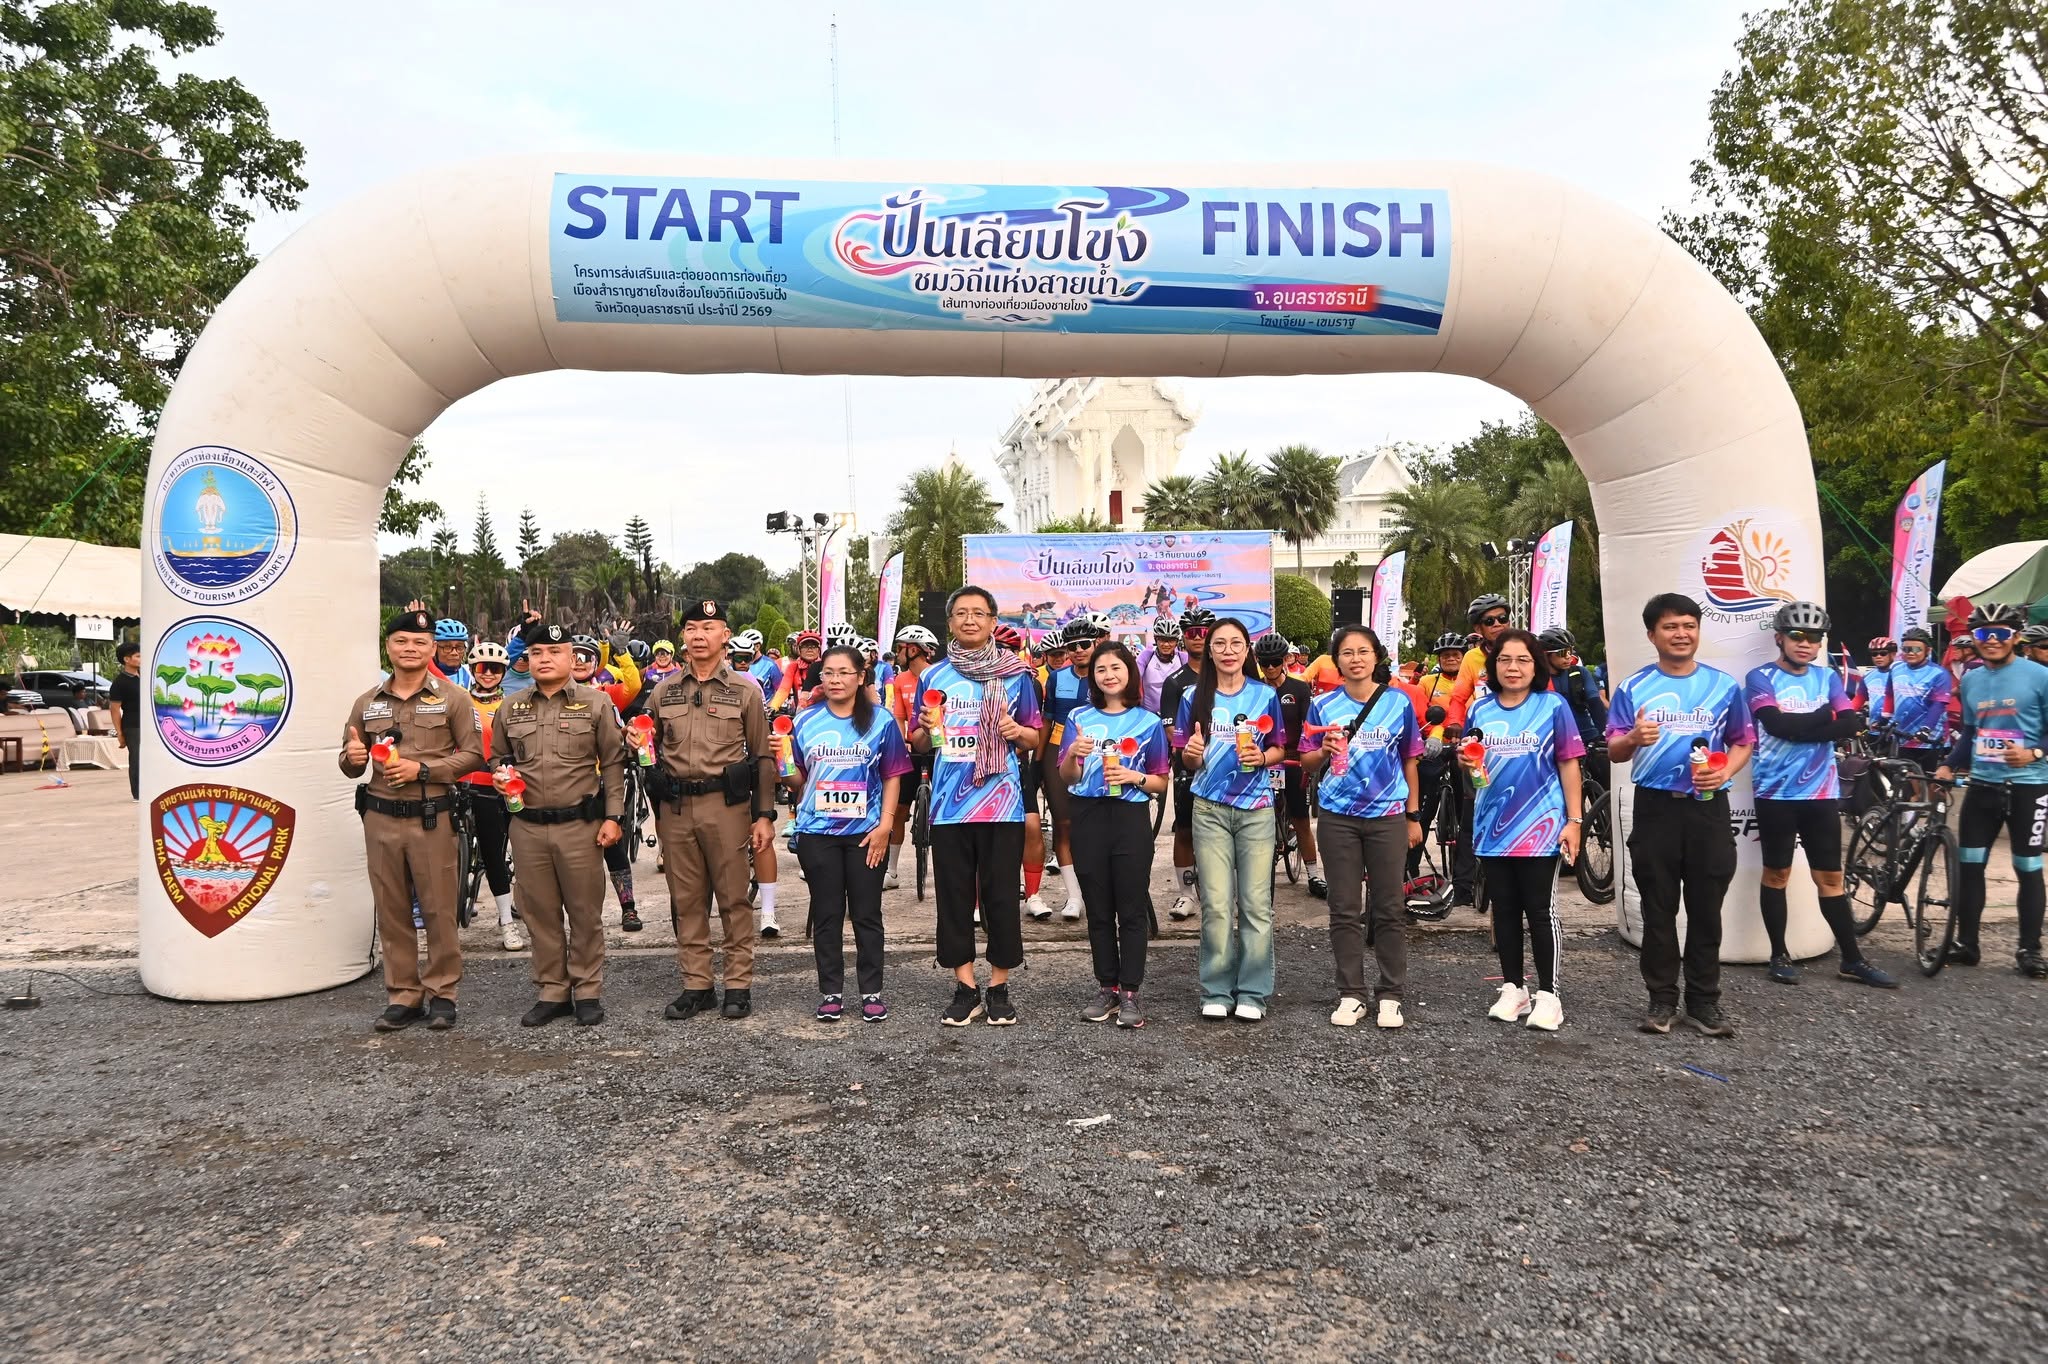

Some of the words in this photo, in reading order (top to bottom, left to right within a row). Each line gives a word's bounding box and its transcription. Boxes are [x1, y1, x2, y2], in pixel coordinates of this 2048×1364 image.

[563, 185, 800, 244] START
[882, 190, 1147, 262] ปั่นเลียบโขง
[1202, 201, 1435, 258] FINISH
[574, 264, 787, 283] โครงการส่งเสริมและต่อยอดการท่องเที่ยว
[914, 264, 1119, 295] ชมวิถีแห่งสายน้ำ
[573, 283, 787, 301] เมืองสำราญชายโขงเชื่อมโยงวิถีเมืองริมฝั่ง
[595, 301, 694, 317] จังหวัดอุบลราชธานี
[698, 303, 738, 316] ประจำปี
[741, 306, 772, 316] 2569
[942, 297, 1088, 311] เส้นทางท่องเที่ยวเมืองชายโขง
[1260, 314, 1306, 328] โขงเจียม
[1316, 317, 1356, 329] เขมราฐ
[156, 554, 179, 589] MINISTRY
[180, 586, 191, 595] OF
[193, 592, 236, 601] TOURISM
[239, 583, 259, 596] AND
[259, 554, 286, 584] SPORTS
[88, 623, 102, 632] VIP
[1735, 610, 1778, 623] Ratcha
[170, 729, 250, 756] จังหวัดอุบลราชธานี
[949, 736, 976, 748] 109
[1269, 770, 1281, 778] 57
[160, 785, 281, 815] อุทยานแห่งชาติผาแต้ม
[823, 791, 860, 804] 1107
[2029, 794, 2048, 846] BORA
[155, 838, 167, 866] PHA
[162, 868, 185, 903] TAEM
[227, 865, 278, 919] NATIONAL
[270, 827, 290, 860] PARK
